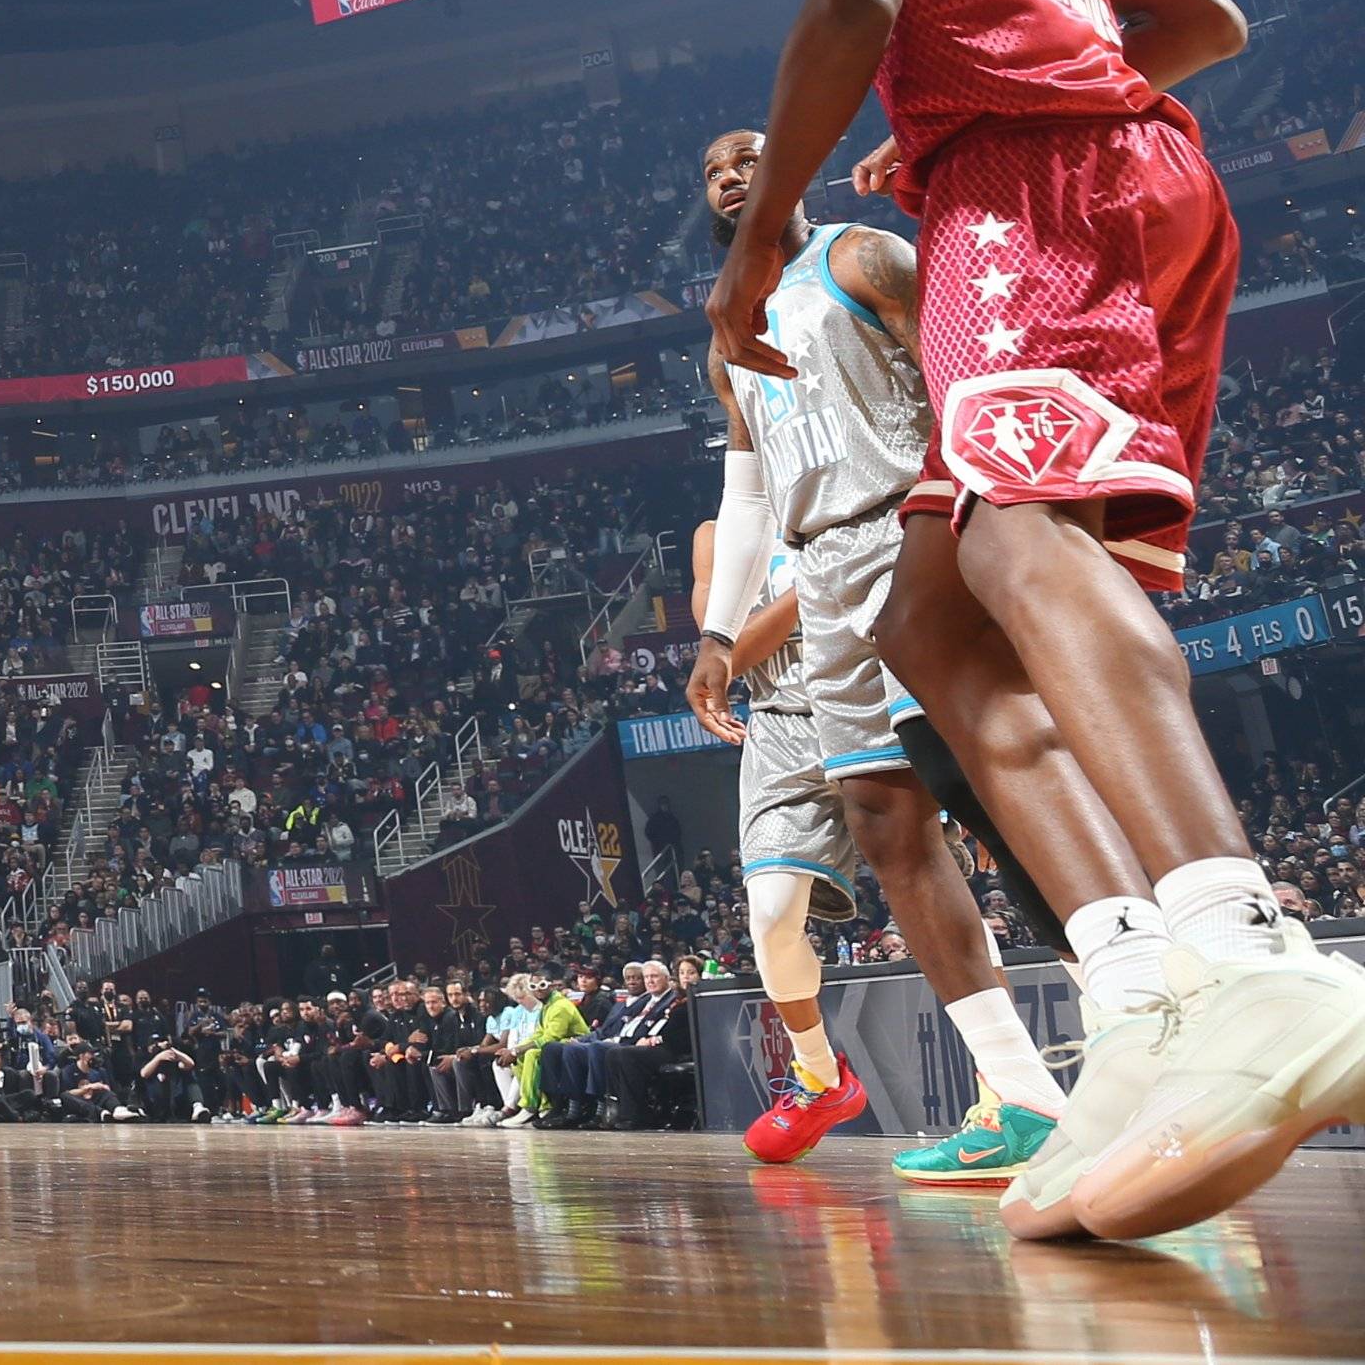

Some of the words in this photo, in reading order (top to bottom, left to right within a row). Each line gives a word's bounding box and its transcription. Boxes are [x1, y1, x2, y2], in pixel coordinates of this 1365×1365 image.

[1221, 151, 1273, 175] CLEVELAND
[362, 339, 393, 365] 2022
[401, 337, 444, 353] CLEVELAND
[86, 370, 174, 395] $150,000
[1029, 410, 1053, 439] 75
[1227, 626, 1242, 658] 4
[1251, 621, 1283, 646] FLS
[1295, 607, 1315, 641] 0
[1332, 595, 1364, 629] 15
[68, 681, 89, 699] 2022
[630, 720, 665, 754] TEAM
[558, 818, 589, 855] CLE
[598, 823, 621, 856] 22
[285, 868, 324, 887] ALL-STAR
